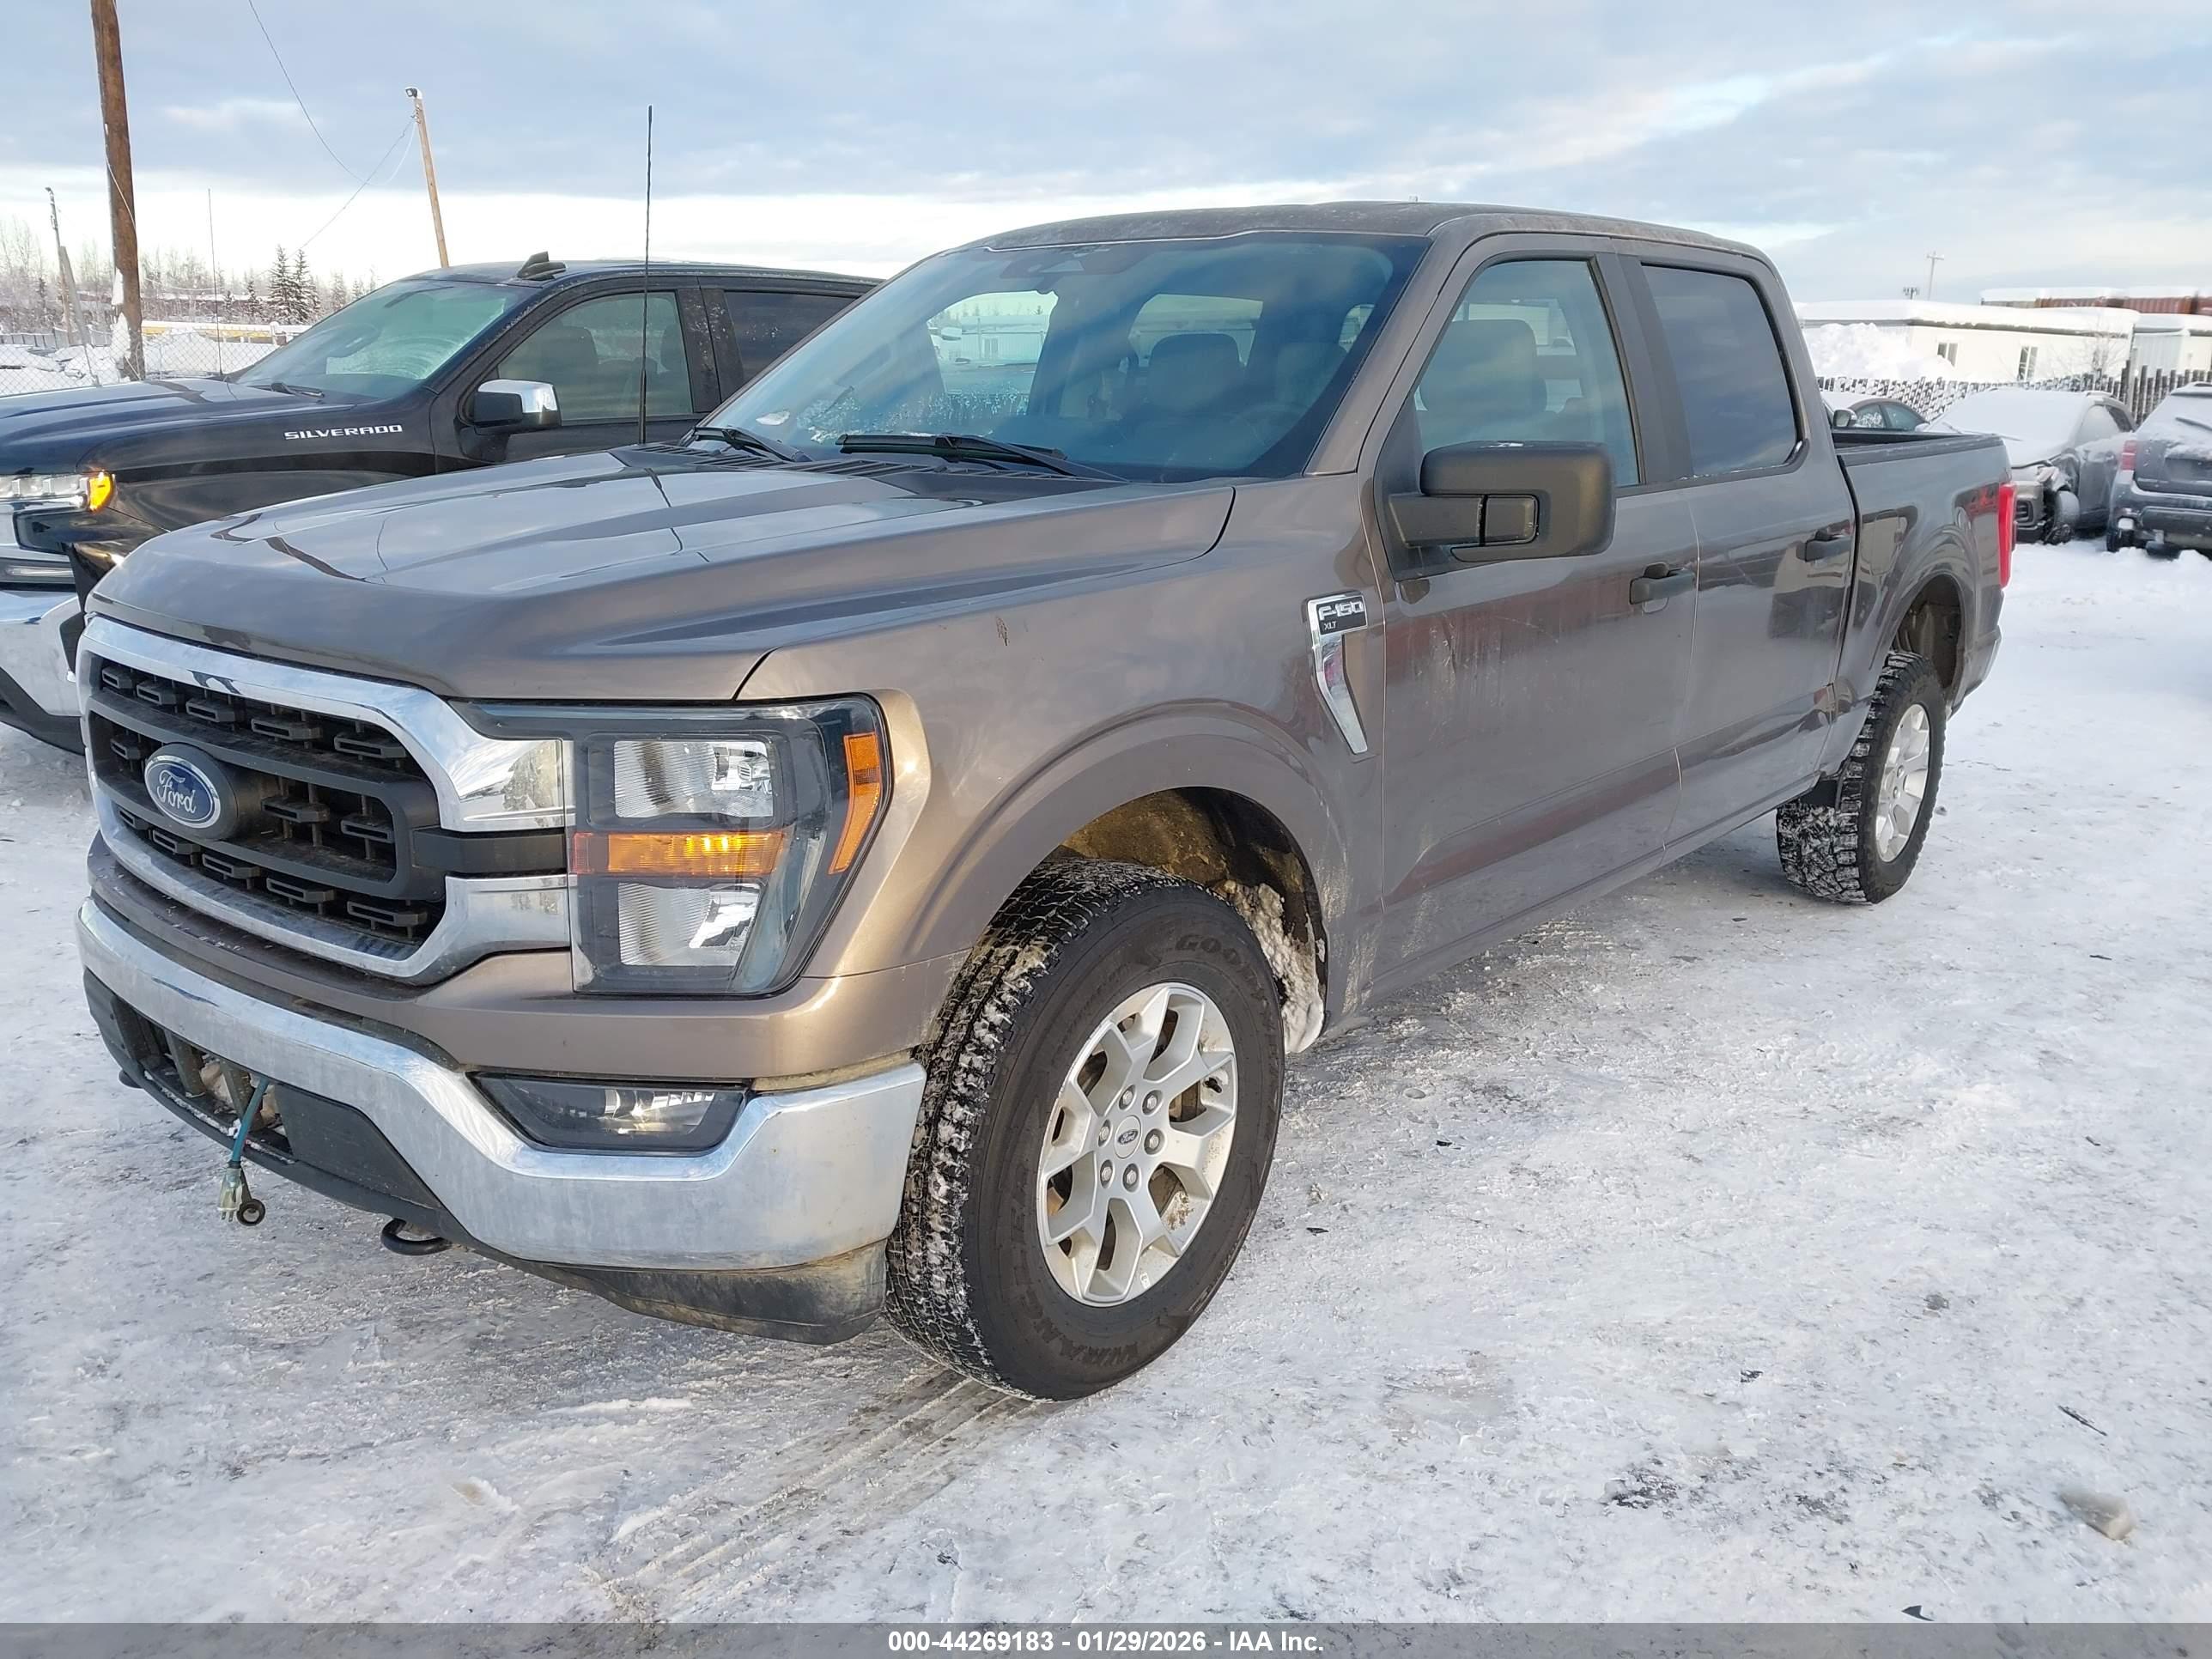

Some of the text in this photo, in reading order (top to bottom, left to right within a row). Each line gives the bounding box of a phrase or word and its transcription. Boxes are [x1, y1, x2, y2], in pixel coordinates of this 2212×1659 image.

[283, 424, 404, 441] SILVERADO
[1318, 601, 1364, 620] F-150
[1323, 620, 1337, 630] XLT
[156, 769, 197, 814] Ford
